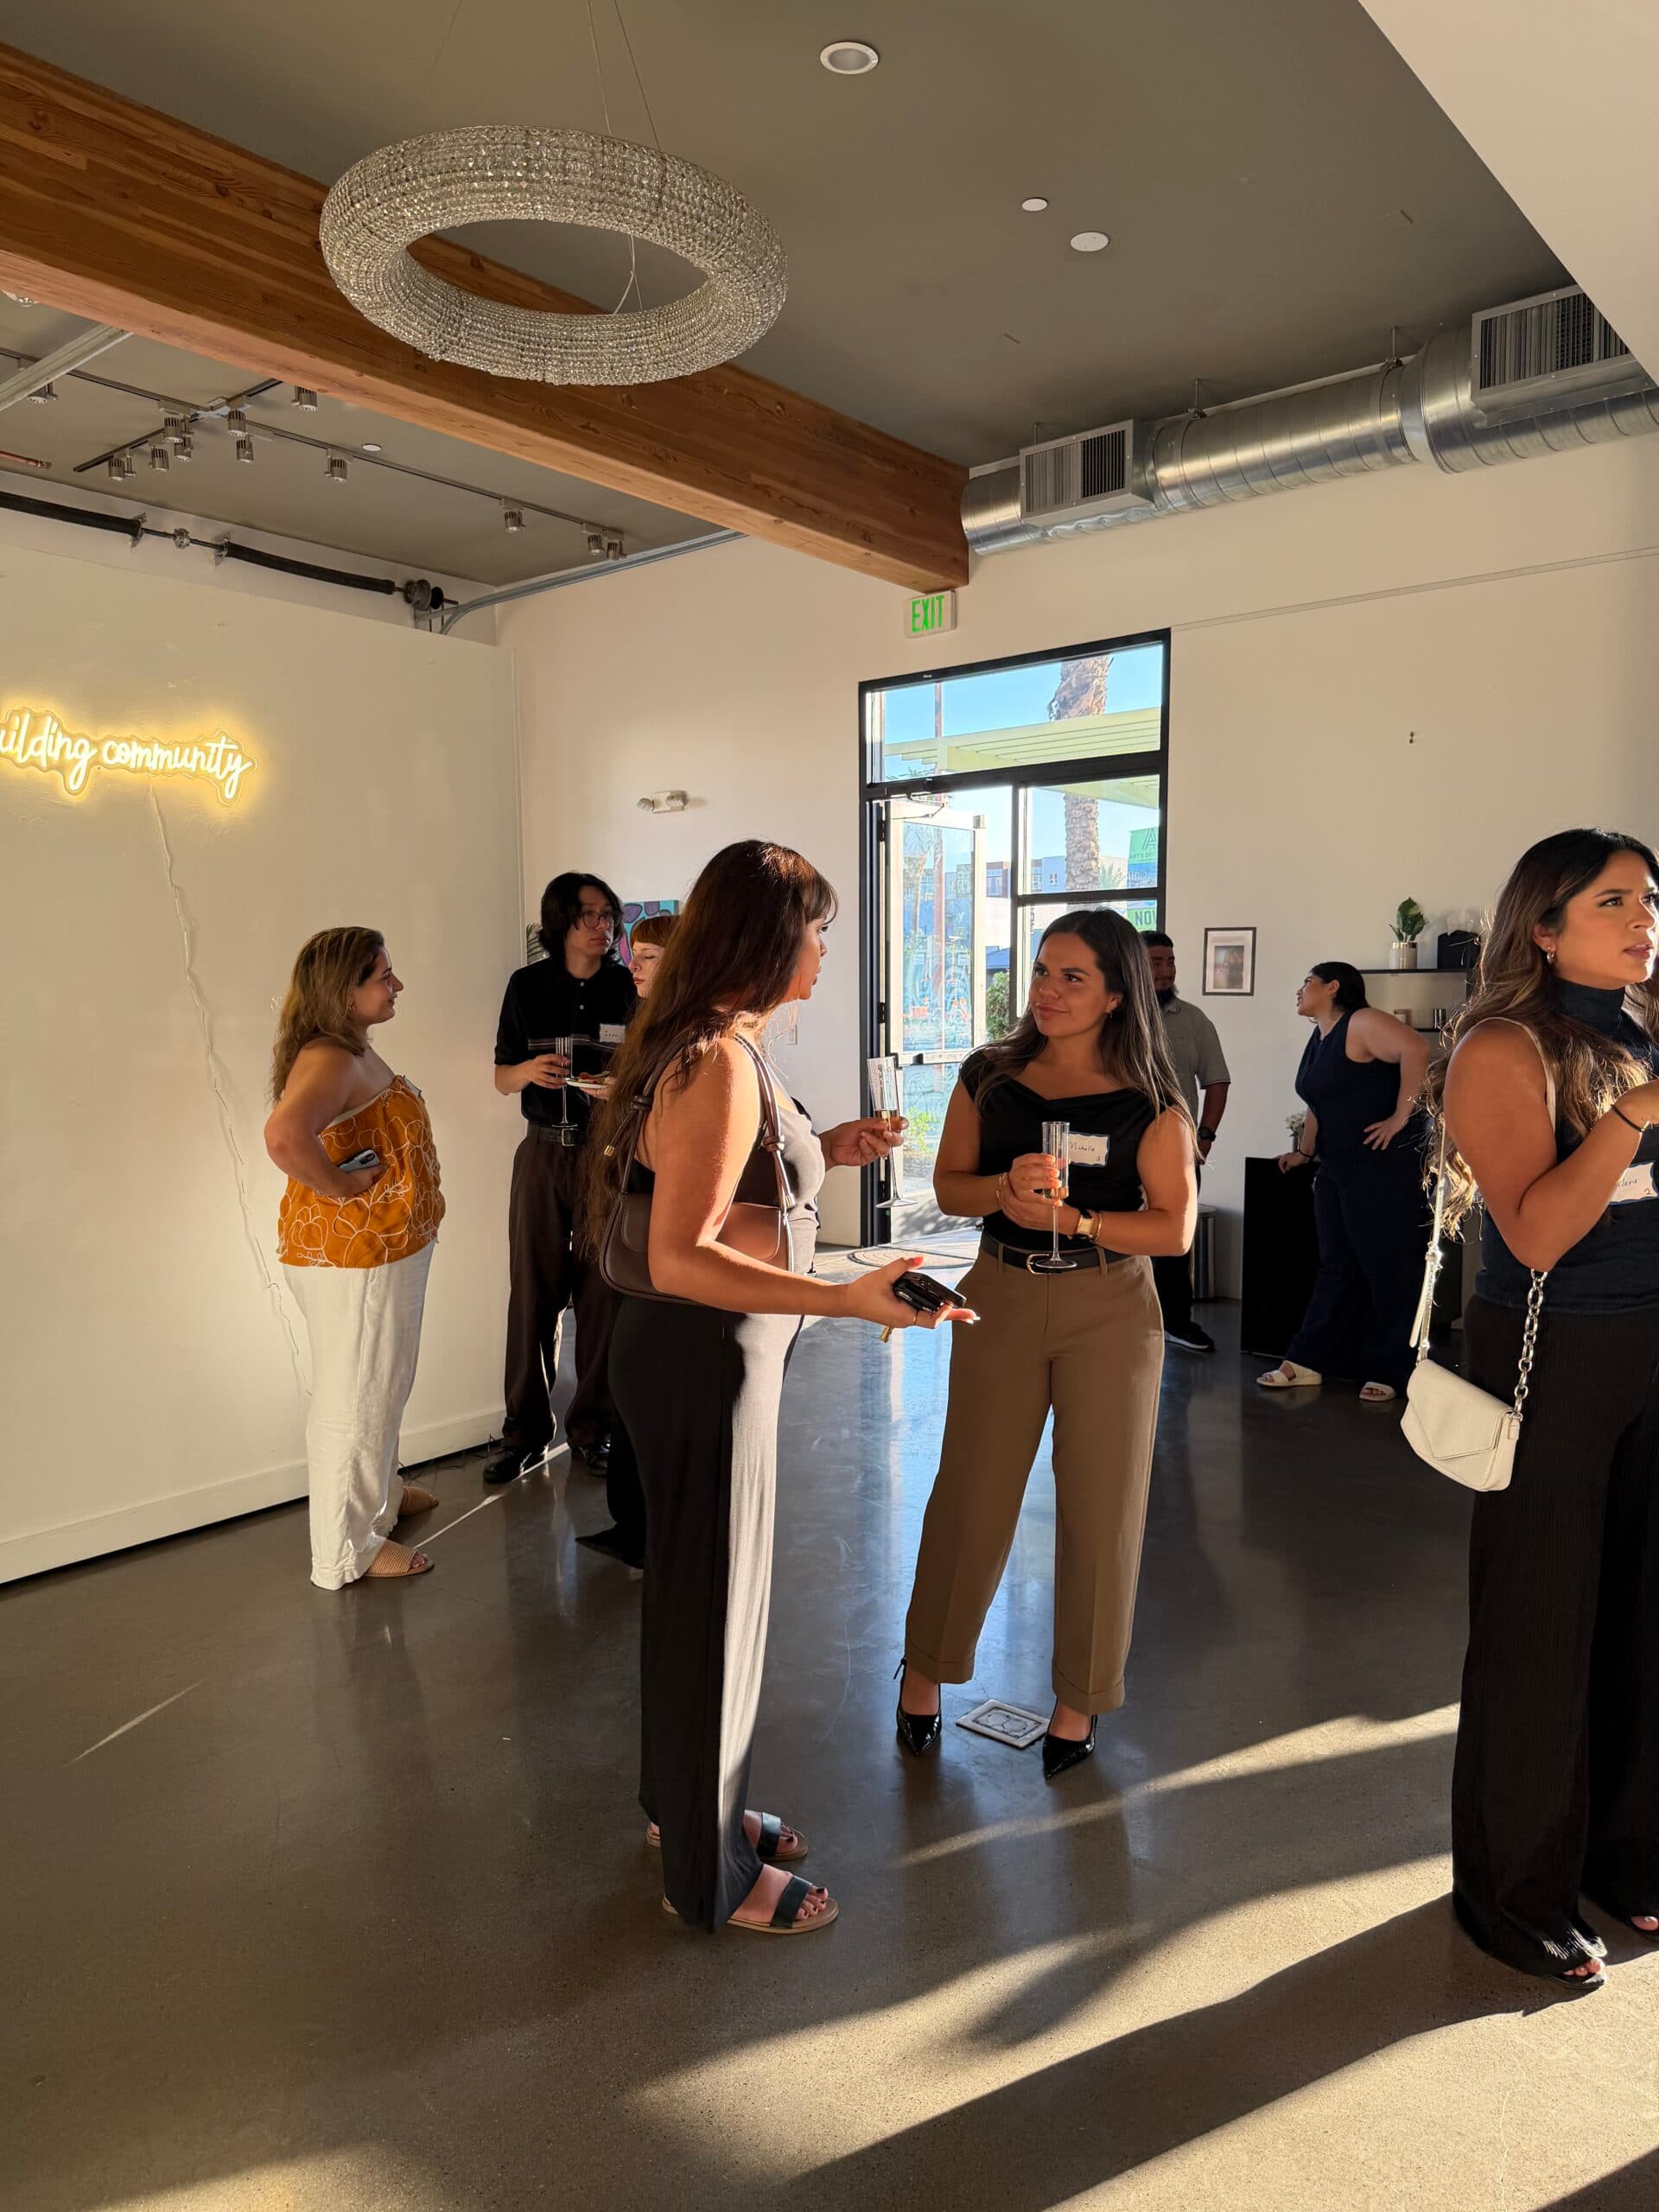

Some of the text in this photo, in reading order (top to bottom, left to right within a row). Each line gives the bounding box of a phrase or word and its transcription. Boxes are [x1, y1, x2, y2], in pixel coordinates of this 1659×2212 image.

[912, 594, 944, 632] EXIT
[102, 736, 252, 799] community
[1135, 910, 1155, 926] NO
[1643, 1187, 1652, 1196] 2
